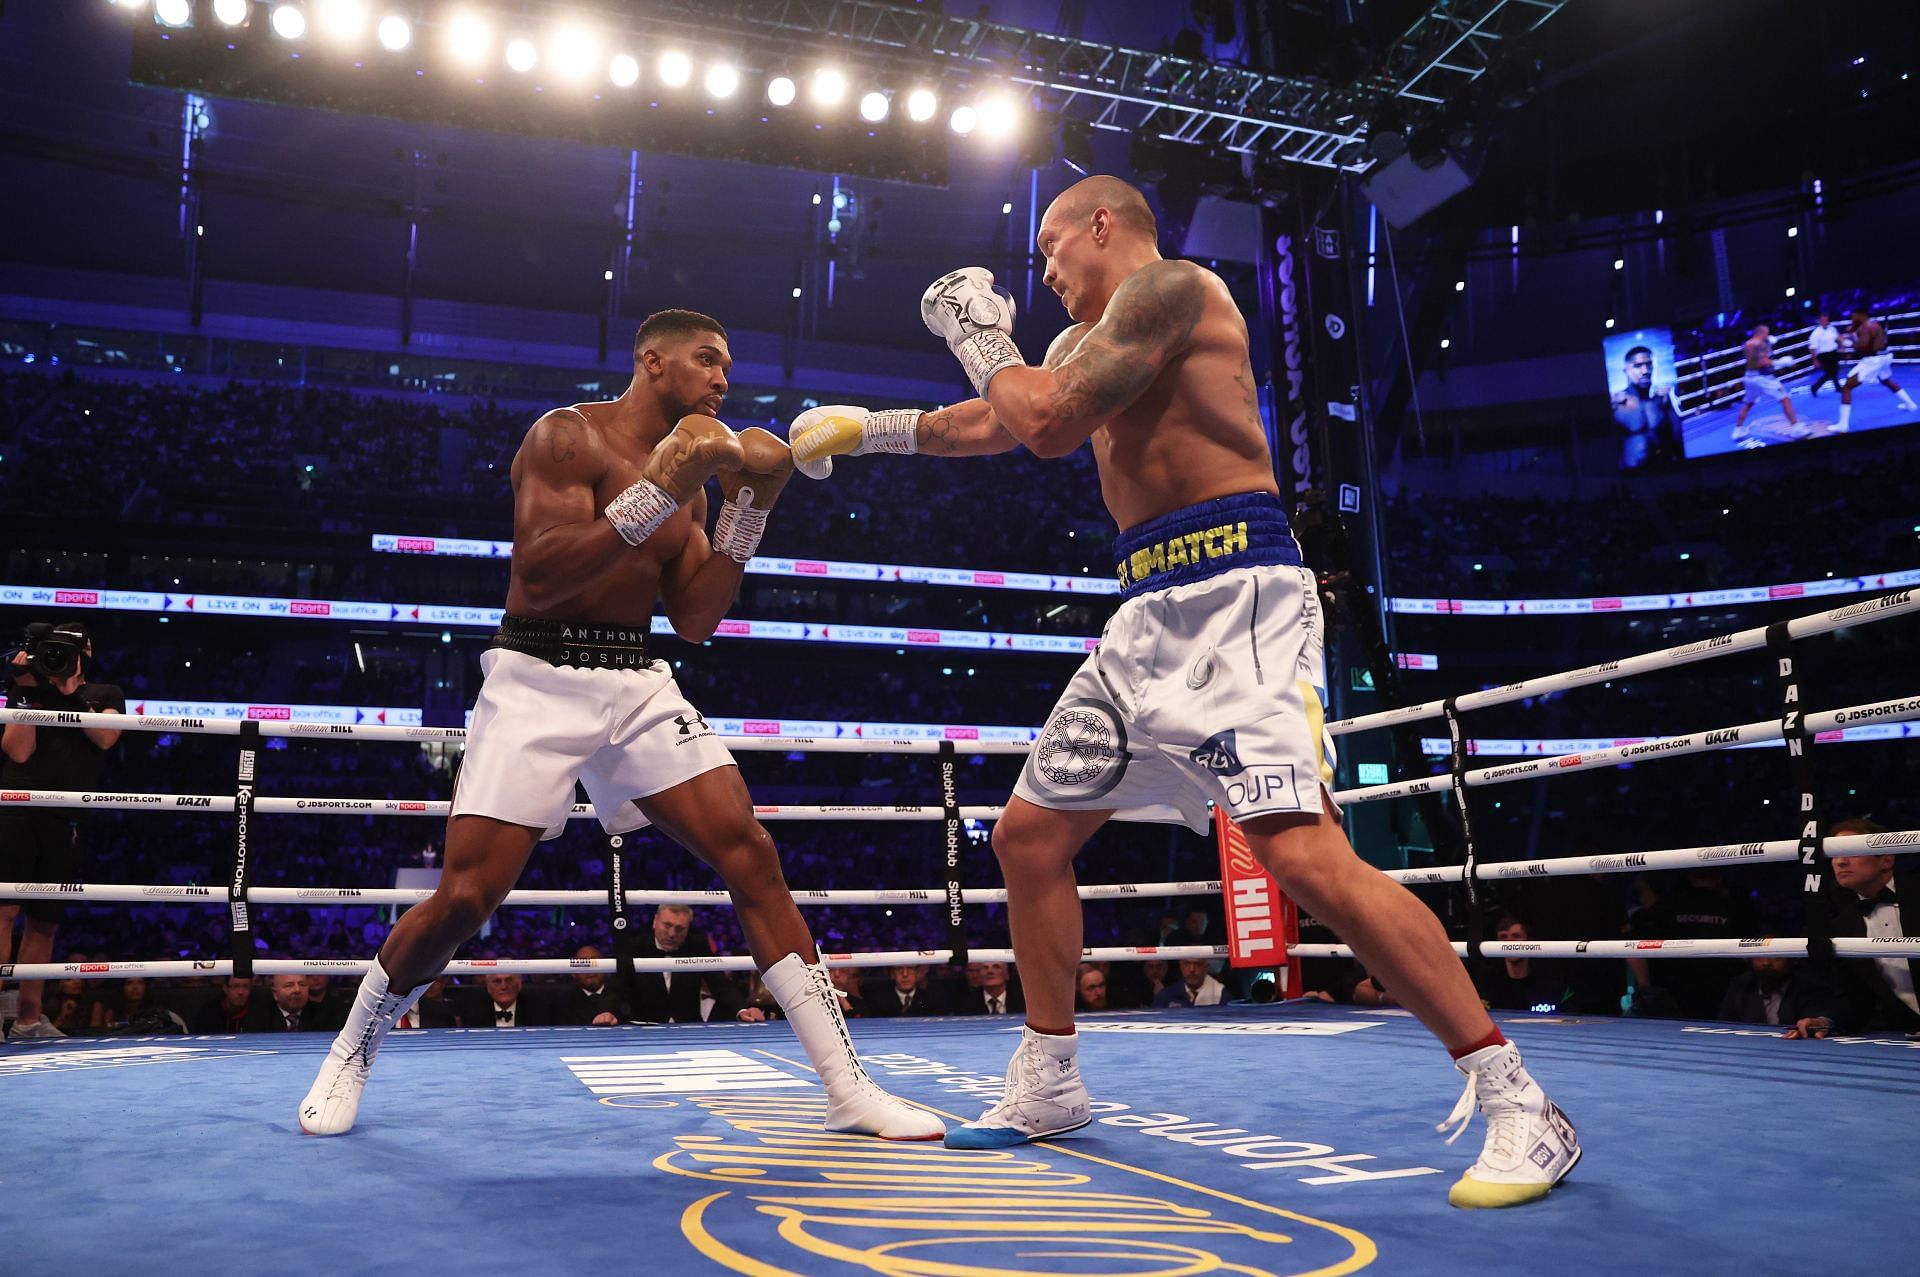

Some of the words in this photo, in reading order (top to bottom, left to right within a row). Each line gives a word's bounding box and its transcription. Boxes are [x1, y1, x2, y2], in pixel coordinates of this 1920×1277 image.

[933, 280, 971, 334] IVAL
[3, 592, 23, 600] ON
[32, 592, 53, 602] sky
[56, 593, 97, 604] sports
[1880, 592, 1911, 608] HILL
[208, 601, 238, 609] LIVE
[242, 602, 260, 611] ON
[269, 602, 287, 613] sky
[291, 603, 330, 615] sports
[351, 607, 377, 615] office
[432, 611, 461, 619] LIVE
[464, 611, 482, 620] ON
[562, 627, 644, 643] ANTHONY
[1708, 634, 1732, 648] HILL
[560, 650, 644, 666] JOSHUA
[159, 706, 192, 715] LIVE
[196, 707, 216, 716] ON
[225, 707, 245, 719] sky
[249, 708, 289, 719] sports
[310, 710, 341, 719] office
[1779, 658, 1803, 757] DAZN
[1848, 700, 1920, 721] JDSPORTS.CO
[13, 710, 57, 723] William
[57, 713, 82, 724] HILL
[181, 718, 205, 729] HILL
[399, 713, 422, 721] LIV
[330, 725, 353, 734] HILL
[675, 734, 697, 747] UNDER
[1630, 738, 1691, 755] JDSPORTS.COM
[1705, 729, 1740, 746] DAZN
[1560, 756, 1581, 767] sports
[1492, 764, 1539, 778] JDSPORTS.COM
[942, 762, 956, 808] StubHub
[1226, 775, 1284, 808] OUP
[1409, 782, 1430, 794] DAZN
[1, 793, 30, 802] sports
[92, 795, 162, 804] JDSPORTS.COM
[176, 796, 211, 807] DAZN
[307, 801, 372, 810] JDSPORTS.COM
[947, 819, 958, 867] StubHub
[1801, 793, 1822, 892] DAZN
[232, 805, 247, 897] PROMOTIONS
[1740, 843, 1765, 856] HILL
[1625, 855, 1647, 867] HILL
[1528, 864, 1548, 875] HILL
[1427, 873, 1443, 882] HILL
[59, 883, 84, 892] HILL
[186, 887, 210, 895] HILL
[1119, 885, 1137, 894] HILL
[909, 890, 928, 899] HILL
[948, 881, 962, 926] StubHub
[1233, 877, 1274, 959] HILL
[1677, 914, 1728, 926] SECURITY
[64, 964, 79, 973] sky
[81, 964, 109, 973] sports
[559, 1049, 818, 1094] HILL
[1098, 1112, 1446, 1187] Home
[1533, 1146, 1552, 1168] BGV
